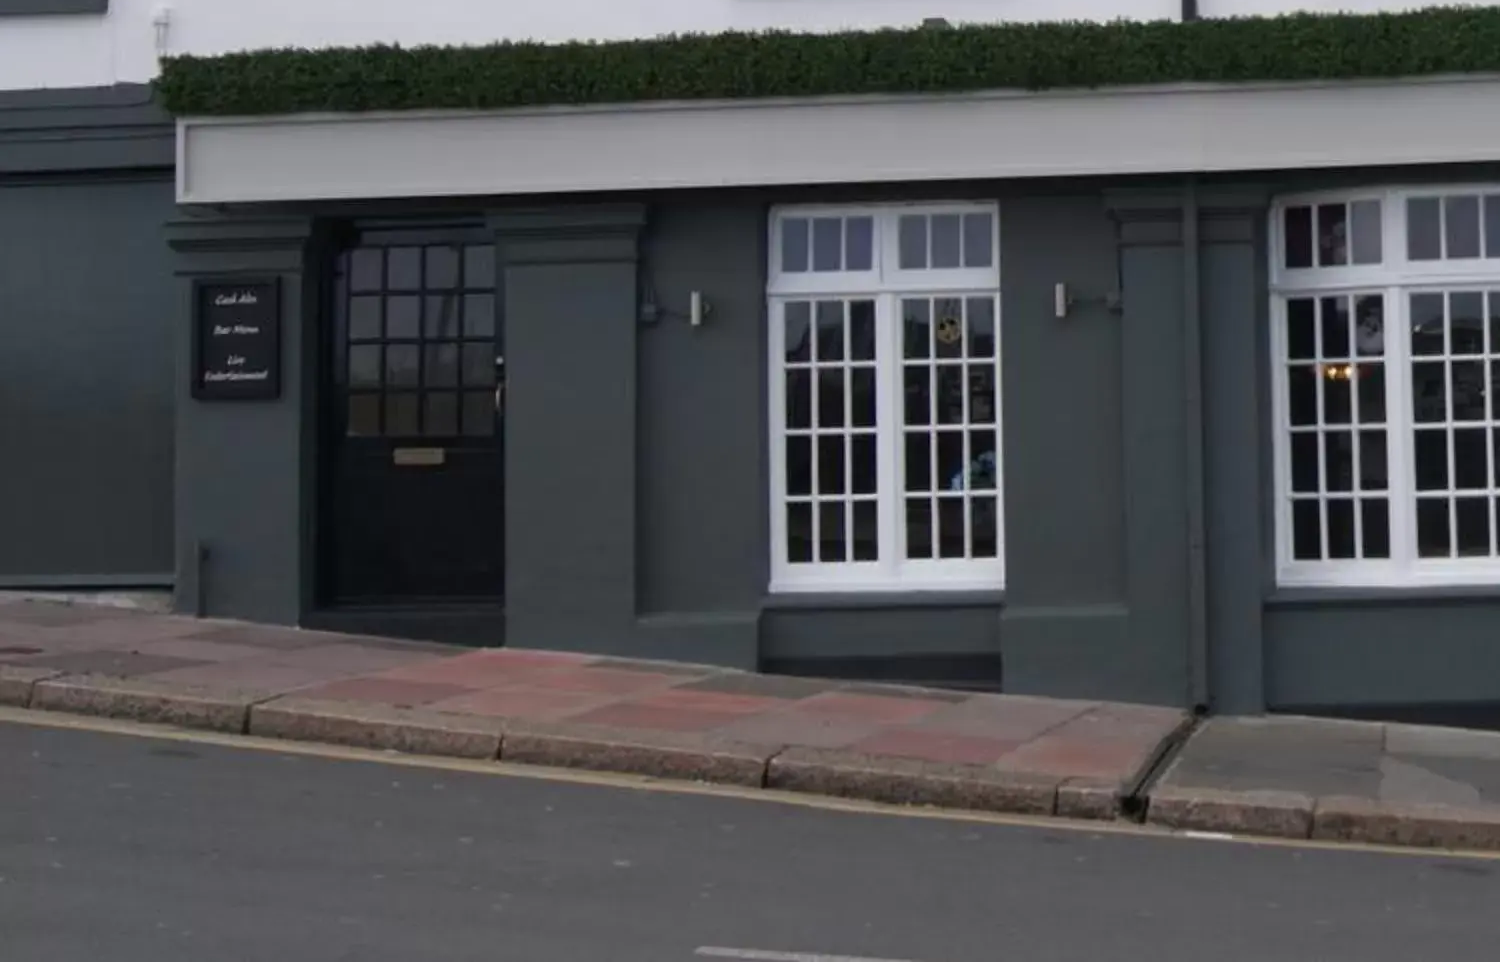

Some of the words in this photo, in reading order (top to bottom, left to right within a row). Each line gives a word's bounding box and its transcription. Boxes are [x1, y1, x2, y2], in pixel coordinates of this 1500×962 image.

[214, 325, 232, 335] Bar
[233, 325, 259, 335] Menu
[227, 354, 246, 365] Live
[204, 370, 268, 382] Entertainment
